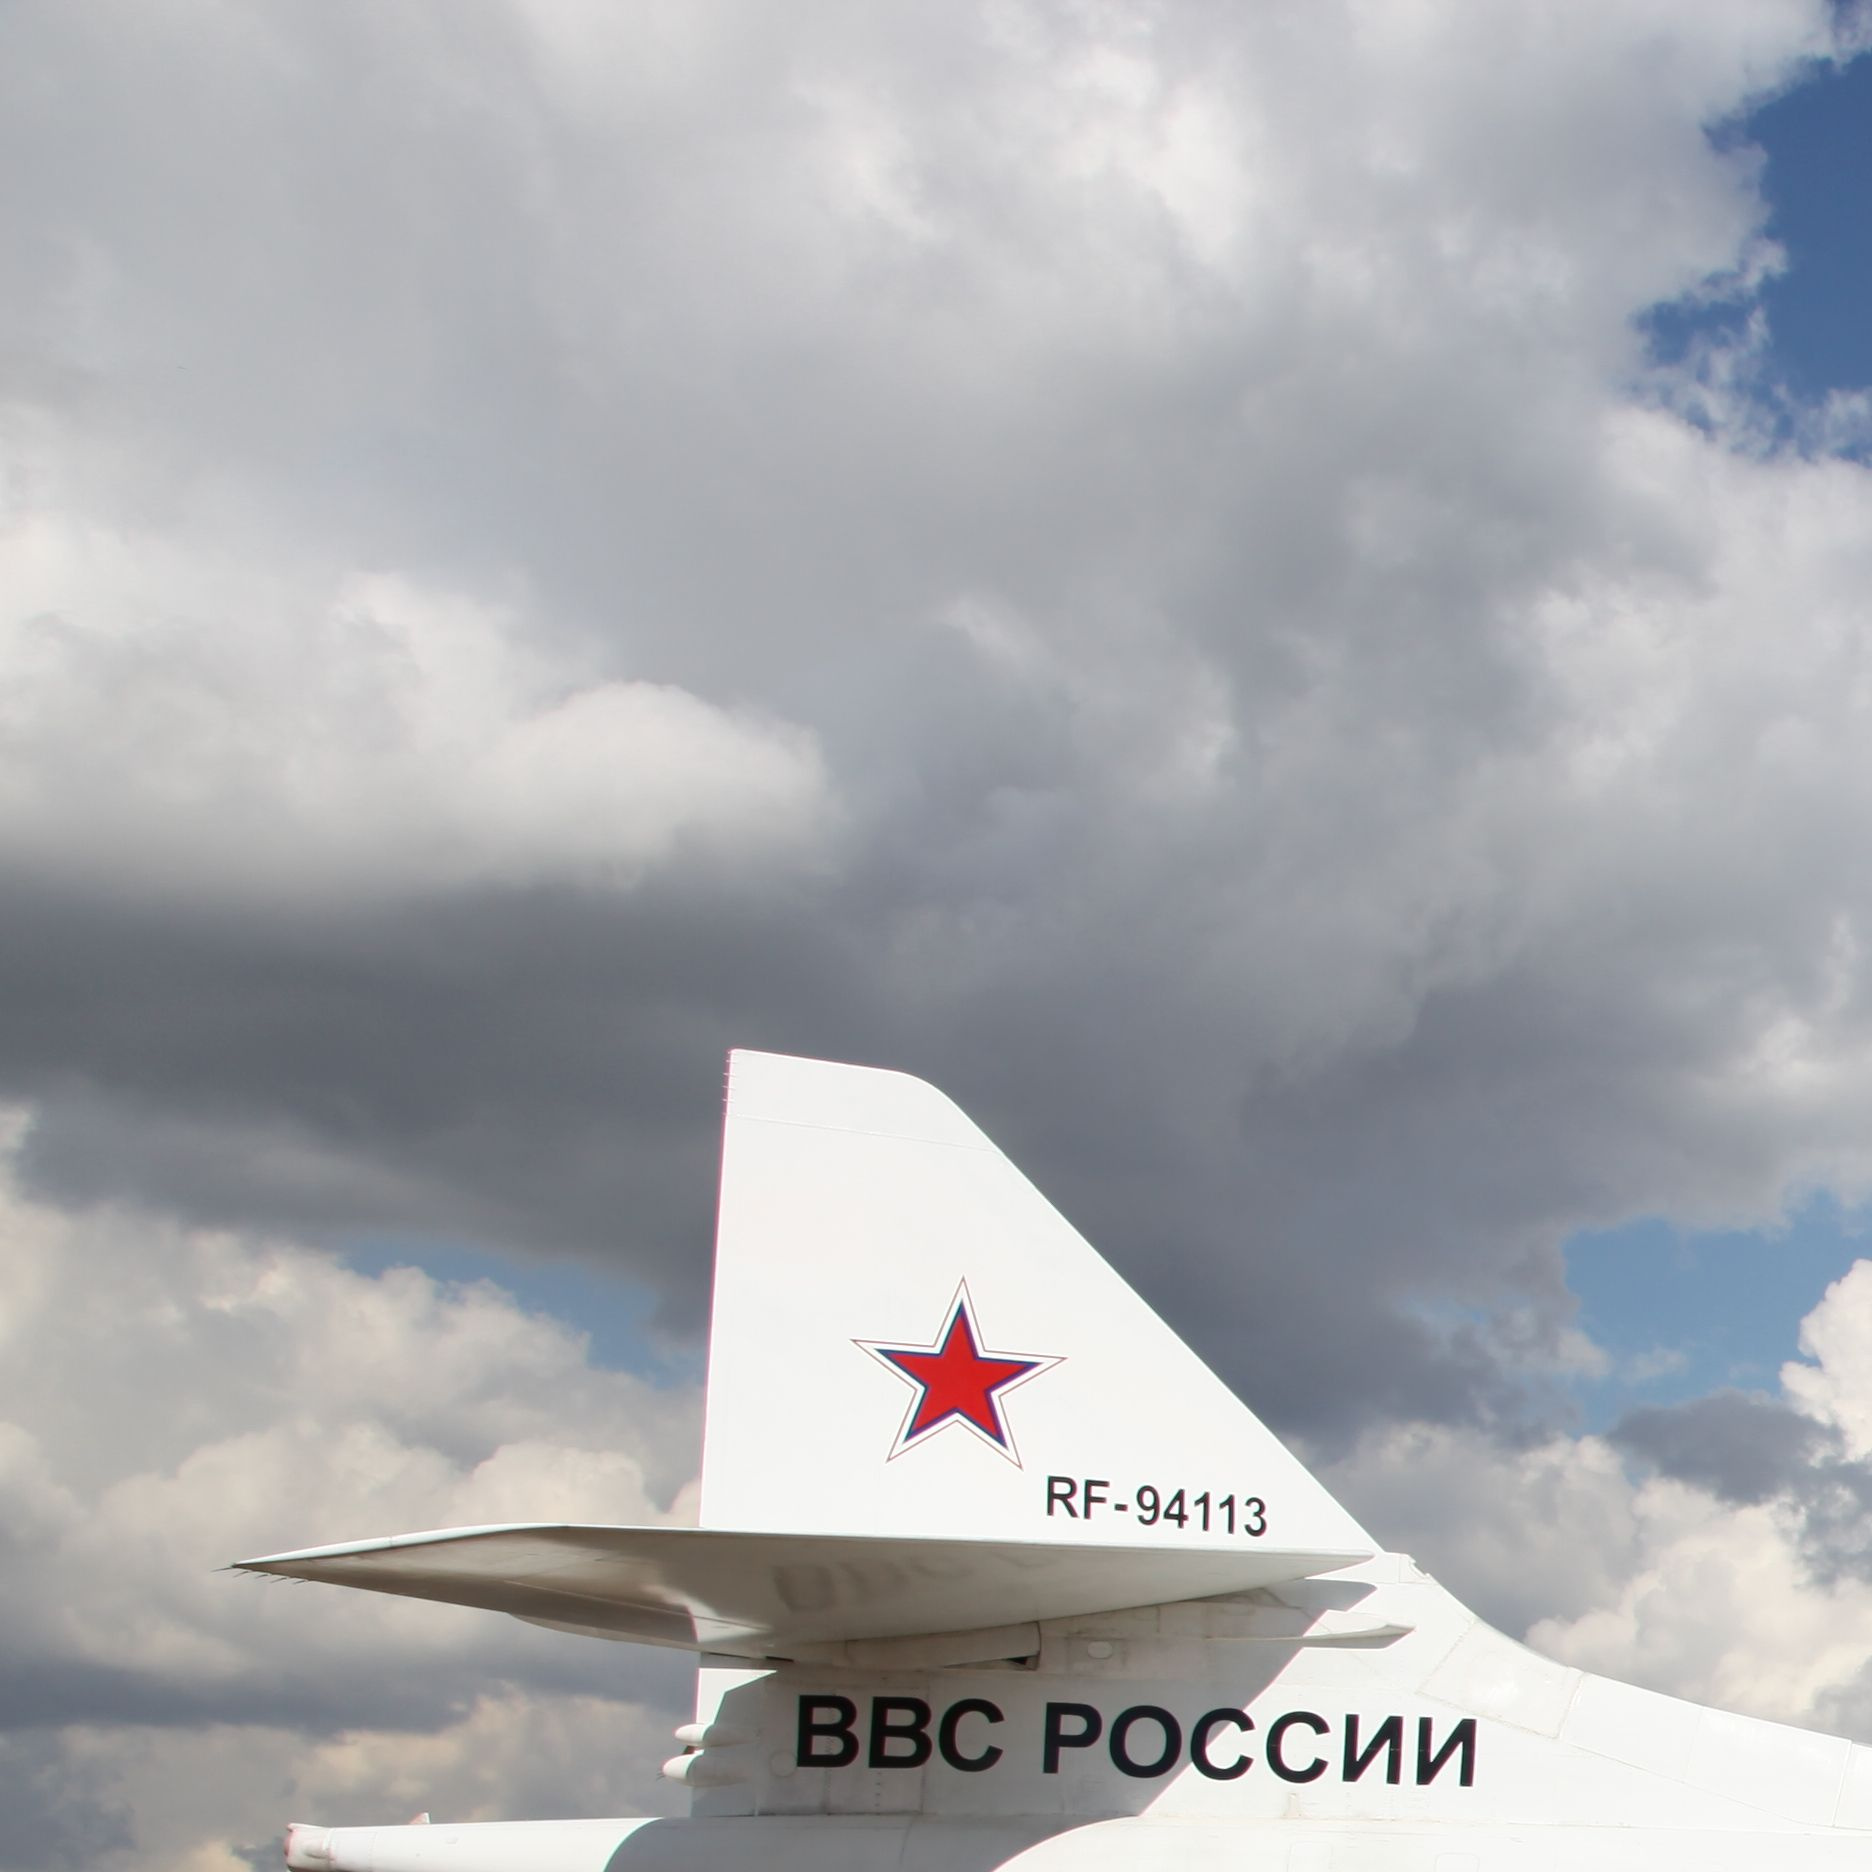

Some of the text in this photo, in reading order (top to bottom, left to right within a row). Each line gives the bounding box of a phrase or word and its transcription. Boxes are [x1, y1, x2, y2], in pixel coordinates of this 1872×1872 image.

[1046, 1475, 1267, 1537] RF-94113
[796, 1693, 1475, 1787] ВВС РОССИИ
